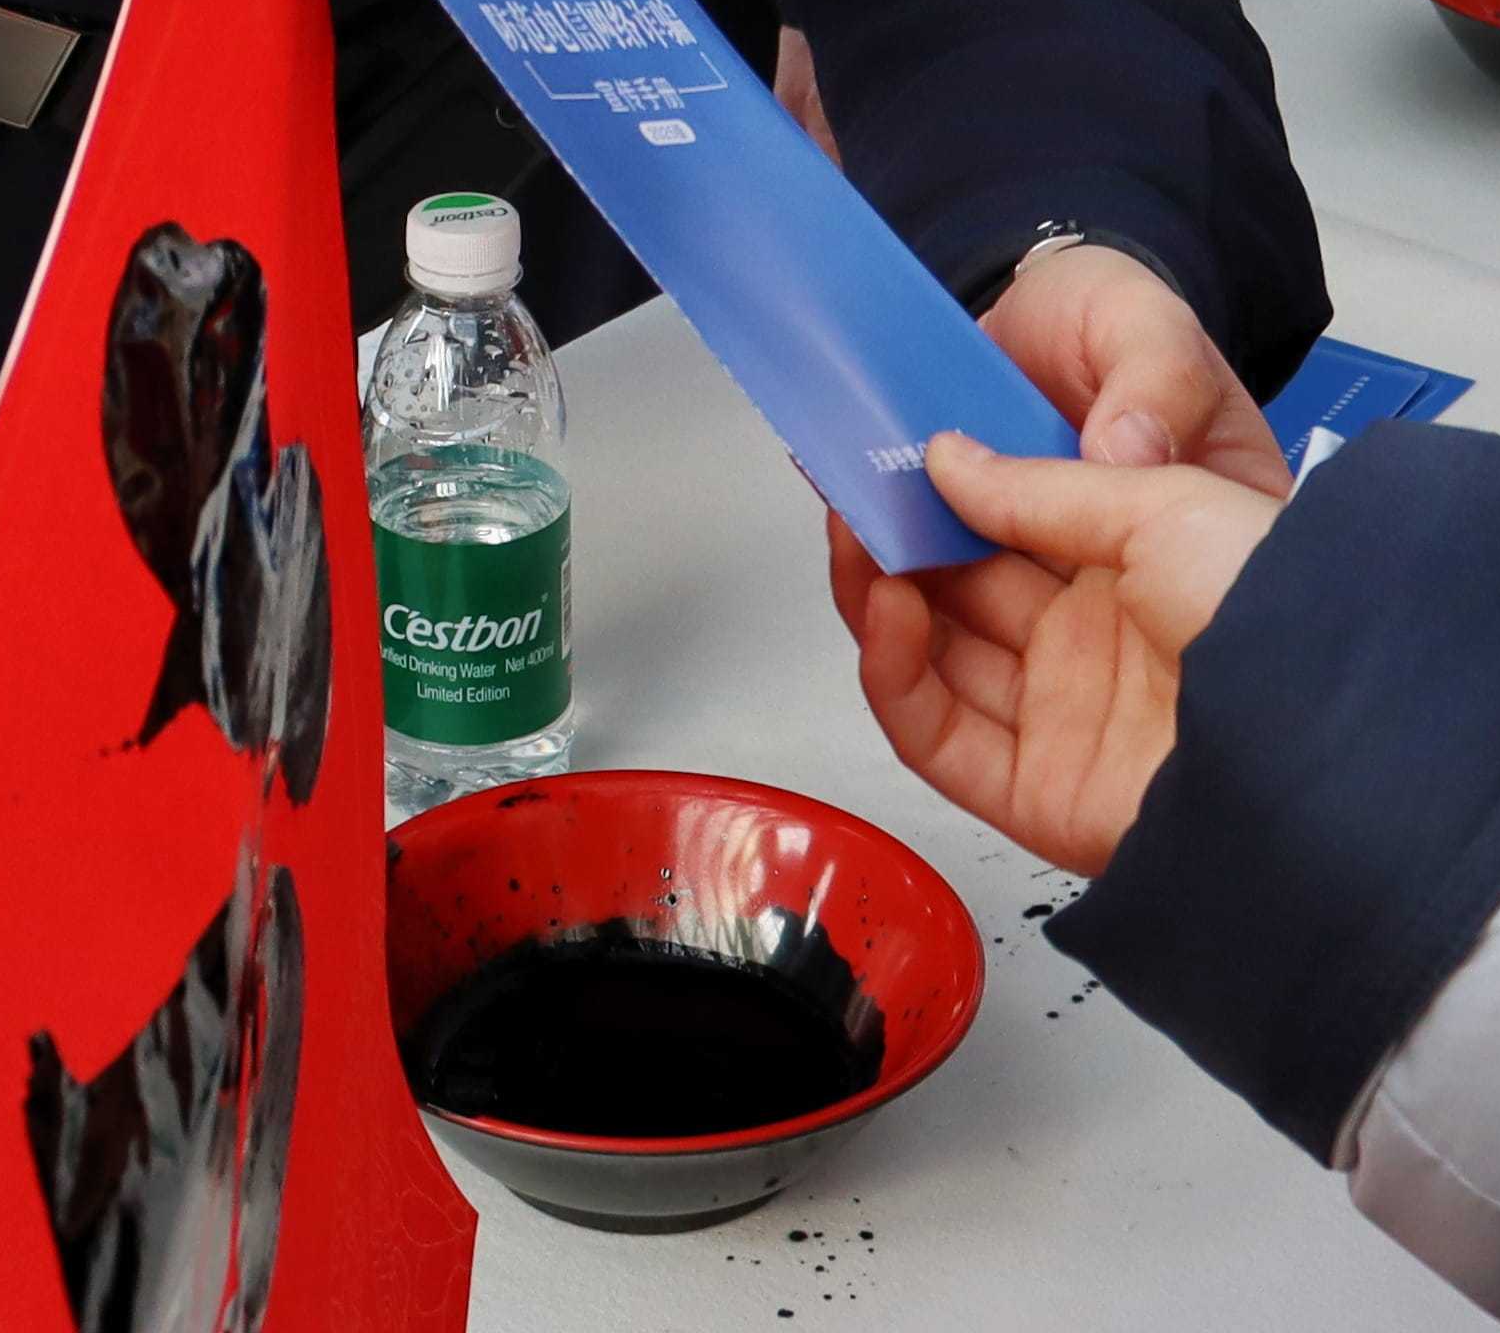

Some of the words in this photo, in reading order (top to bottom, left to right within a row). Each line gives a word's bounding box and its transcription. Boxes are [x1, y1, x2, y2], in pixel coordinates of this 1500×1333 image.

[593, 76, 687, 113] 宣传手册
[408, 655, 457, 681] Drinking
[459, 662, 497, 679] Water
[505, 657, 526, 674] Net
[416, 680, 463, 704] Limited
[466, 684, 511, 704] Edition
